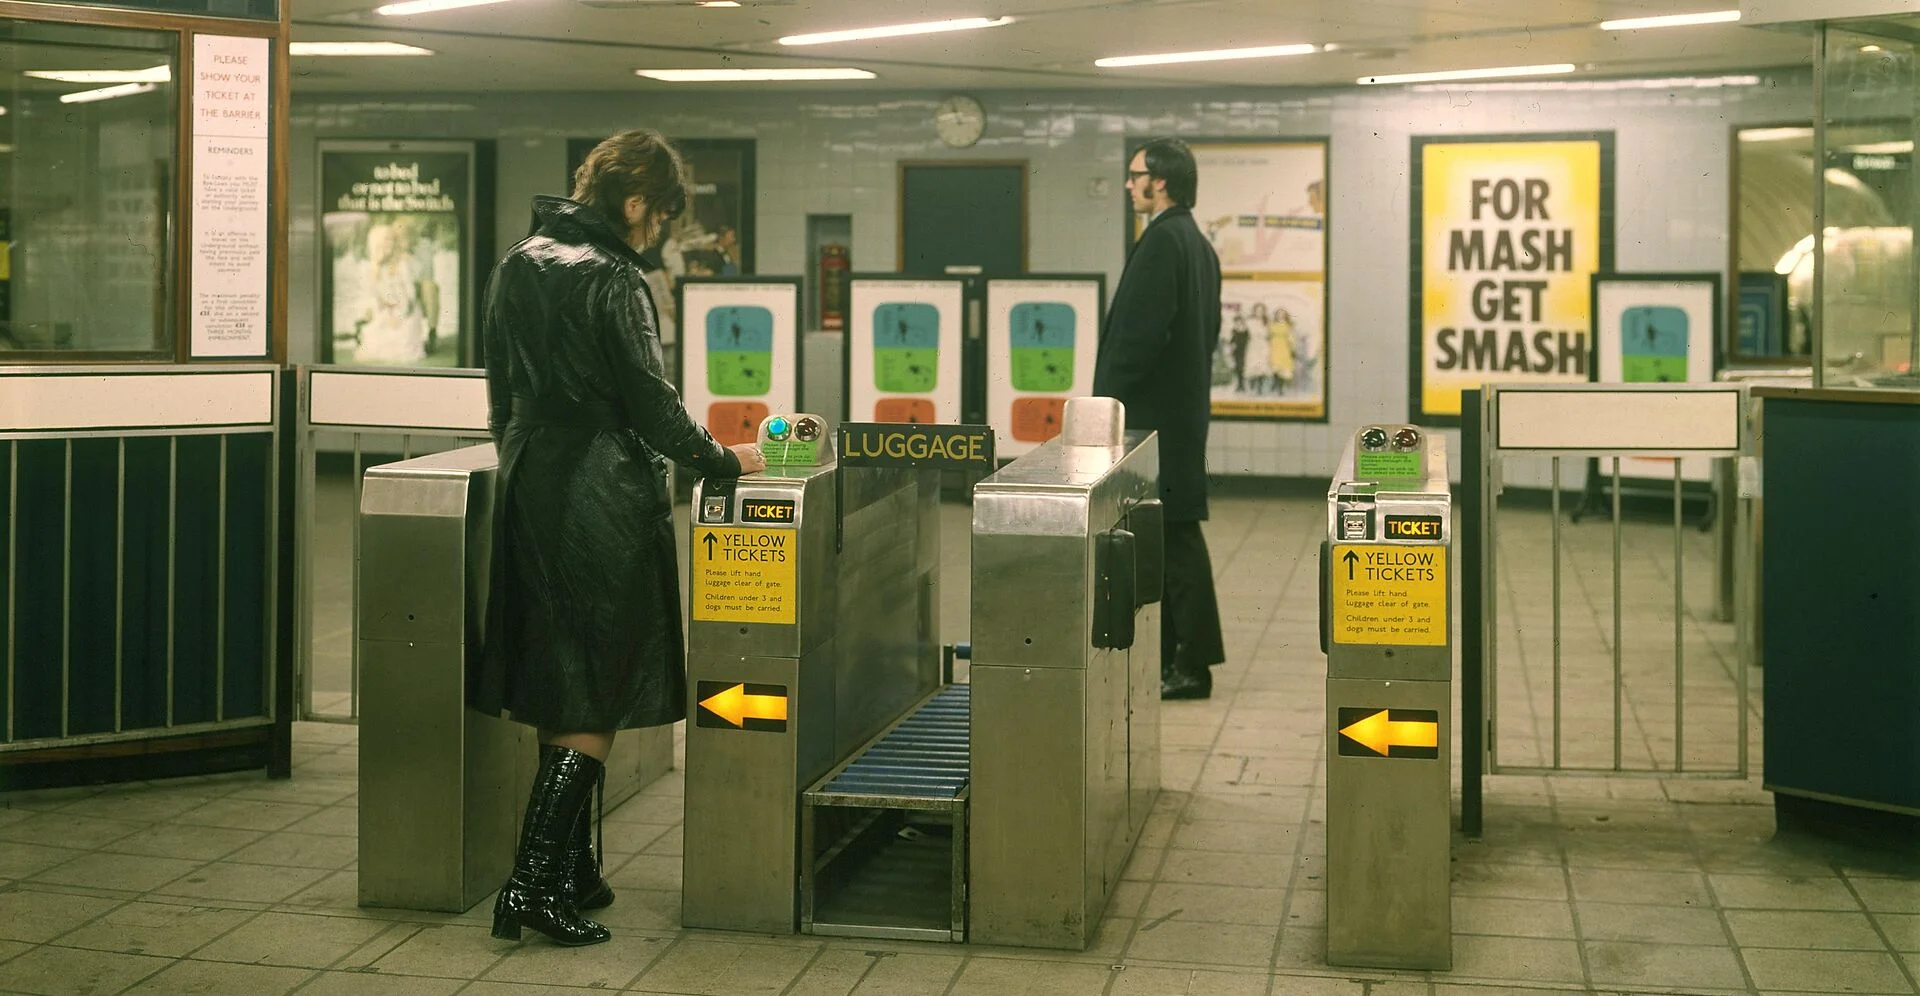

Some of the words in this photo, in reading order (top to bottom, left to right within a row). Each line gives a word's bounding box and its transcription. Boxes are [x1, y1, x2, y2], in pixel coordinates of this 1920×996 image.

[213, 54, 249, 66] PLEASE
[199, 71, 231, 82] SHOW
[234, 73, 261, 84] YOUR
[205, 90, 240, 101] TICKET
[243, 92, 256, 102] AT
[199, 108, 218, 118] THE
[222, 109, 261, 120] BARRIER
[207, 146, 254, 156] REMINDERS
[1471, 178, 1551, 221] FOR
[1448, 229, 1572, 271] MASH
[1472, 279, 1548, 322] GET
[1435, 327, 1585, 375] SMASH
[845, 432, 985, 460] LUGGAGE
[746, 504, 793, 519] TICKET
[1388, 521, 1440, 535] TICKET
[723, 534, 786, 548] YELLOW
[723, 548, 786, 562] TICKETS
[1365, 552, 1434, 566] YELLOW
[705, 568, 727, 577] Please
[730, 568, 741, 577] lift
[744, 569, 761, 577] hand
[1365, 567, 1434, 581] TICKETS
[705, 579, 731, 588] luggage
[734, 579, 752, 587] clear
[705, 593, 735, 601] Children
[738, 594, 759, 602] under
[761, 594, 767, 602] 3
[769, 595, 782, 603] and
[1346, 589, 1369, 597] Please
[1373, 589, 1385, 597] lift
[705, 603, 721, 611] dogs
[1346, 600, 1374, 608] luggage
[1346, 614, 1379, 622] Children
[1383, 615, 1404, 623] under
